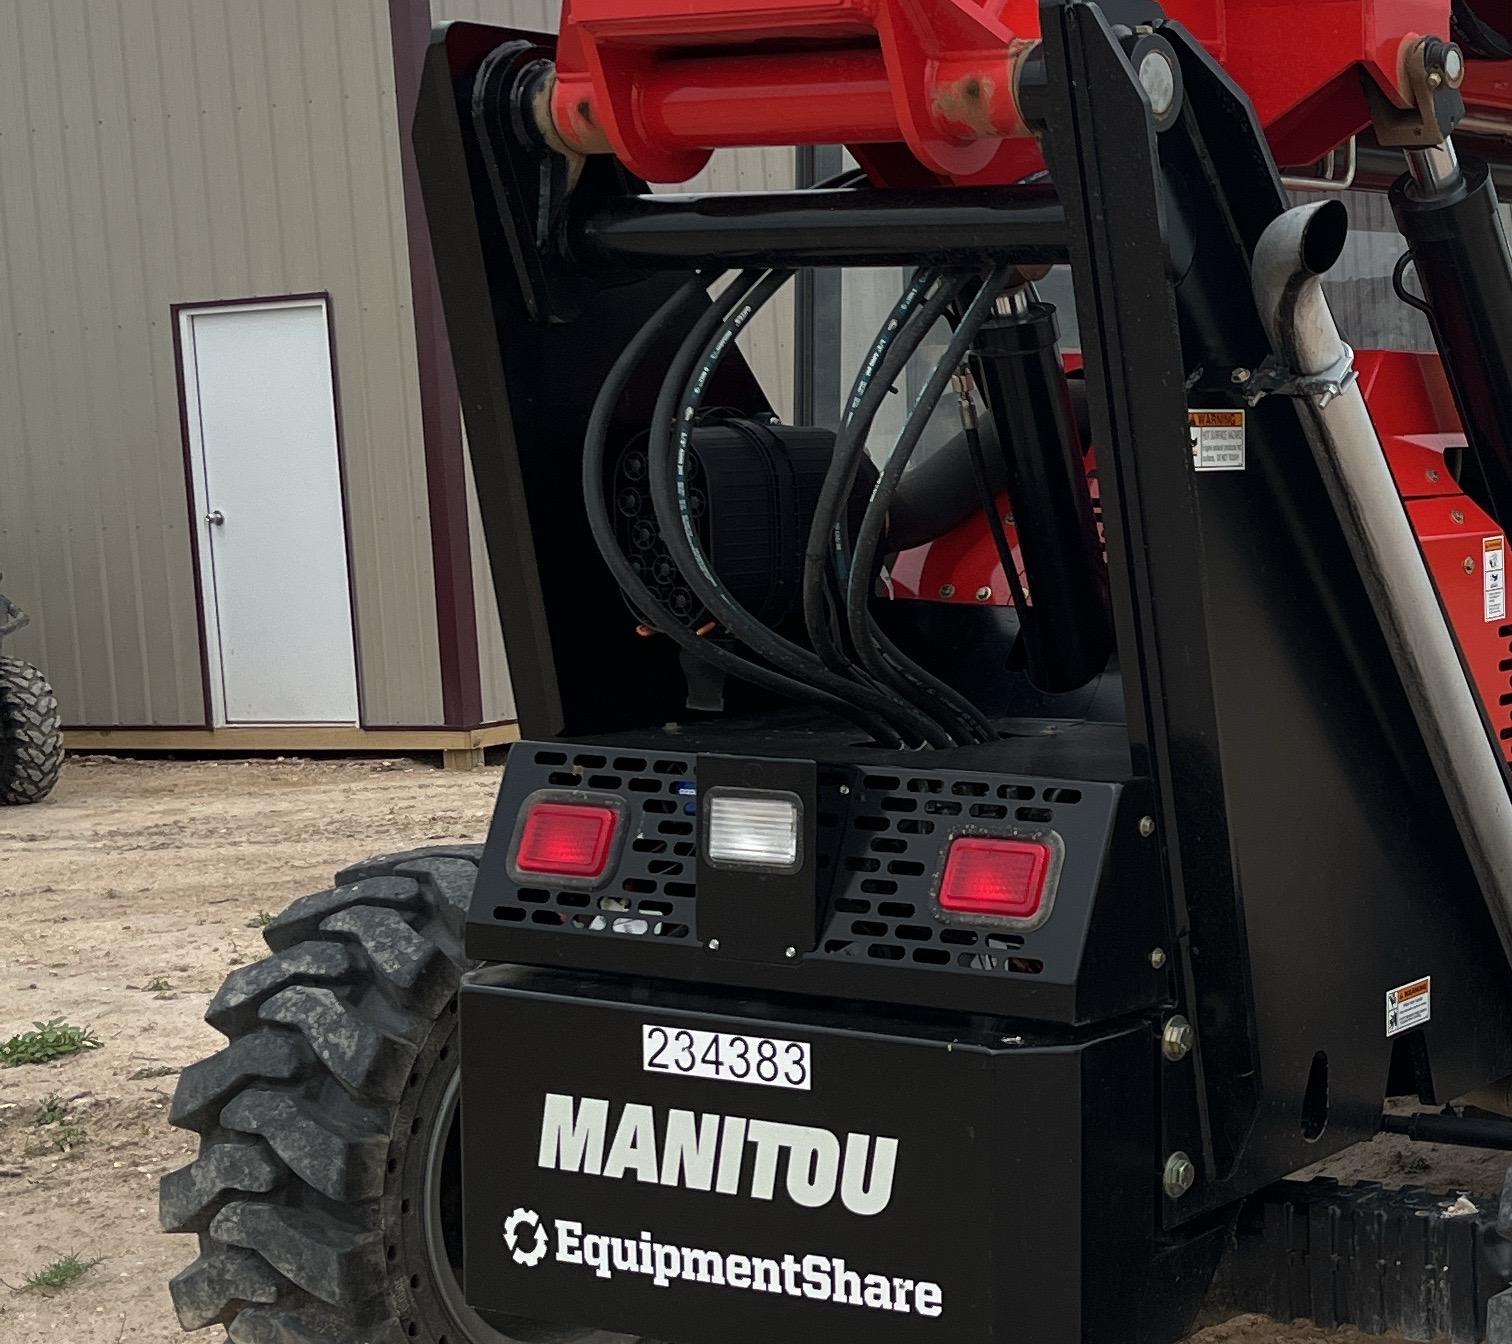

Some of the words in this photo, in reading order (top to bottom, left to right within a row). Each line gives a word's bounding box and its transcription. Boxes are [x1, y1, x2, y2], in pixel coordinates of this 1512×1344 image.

[646, 1027, 807, 1086] 234383
[537, 1092, 899, 1216] MANITOU
[554, 1218, 943, 1318] EquipmentShare
